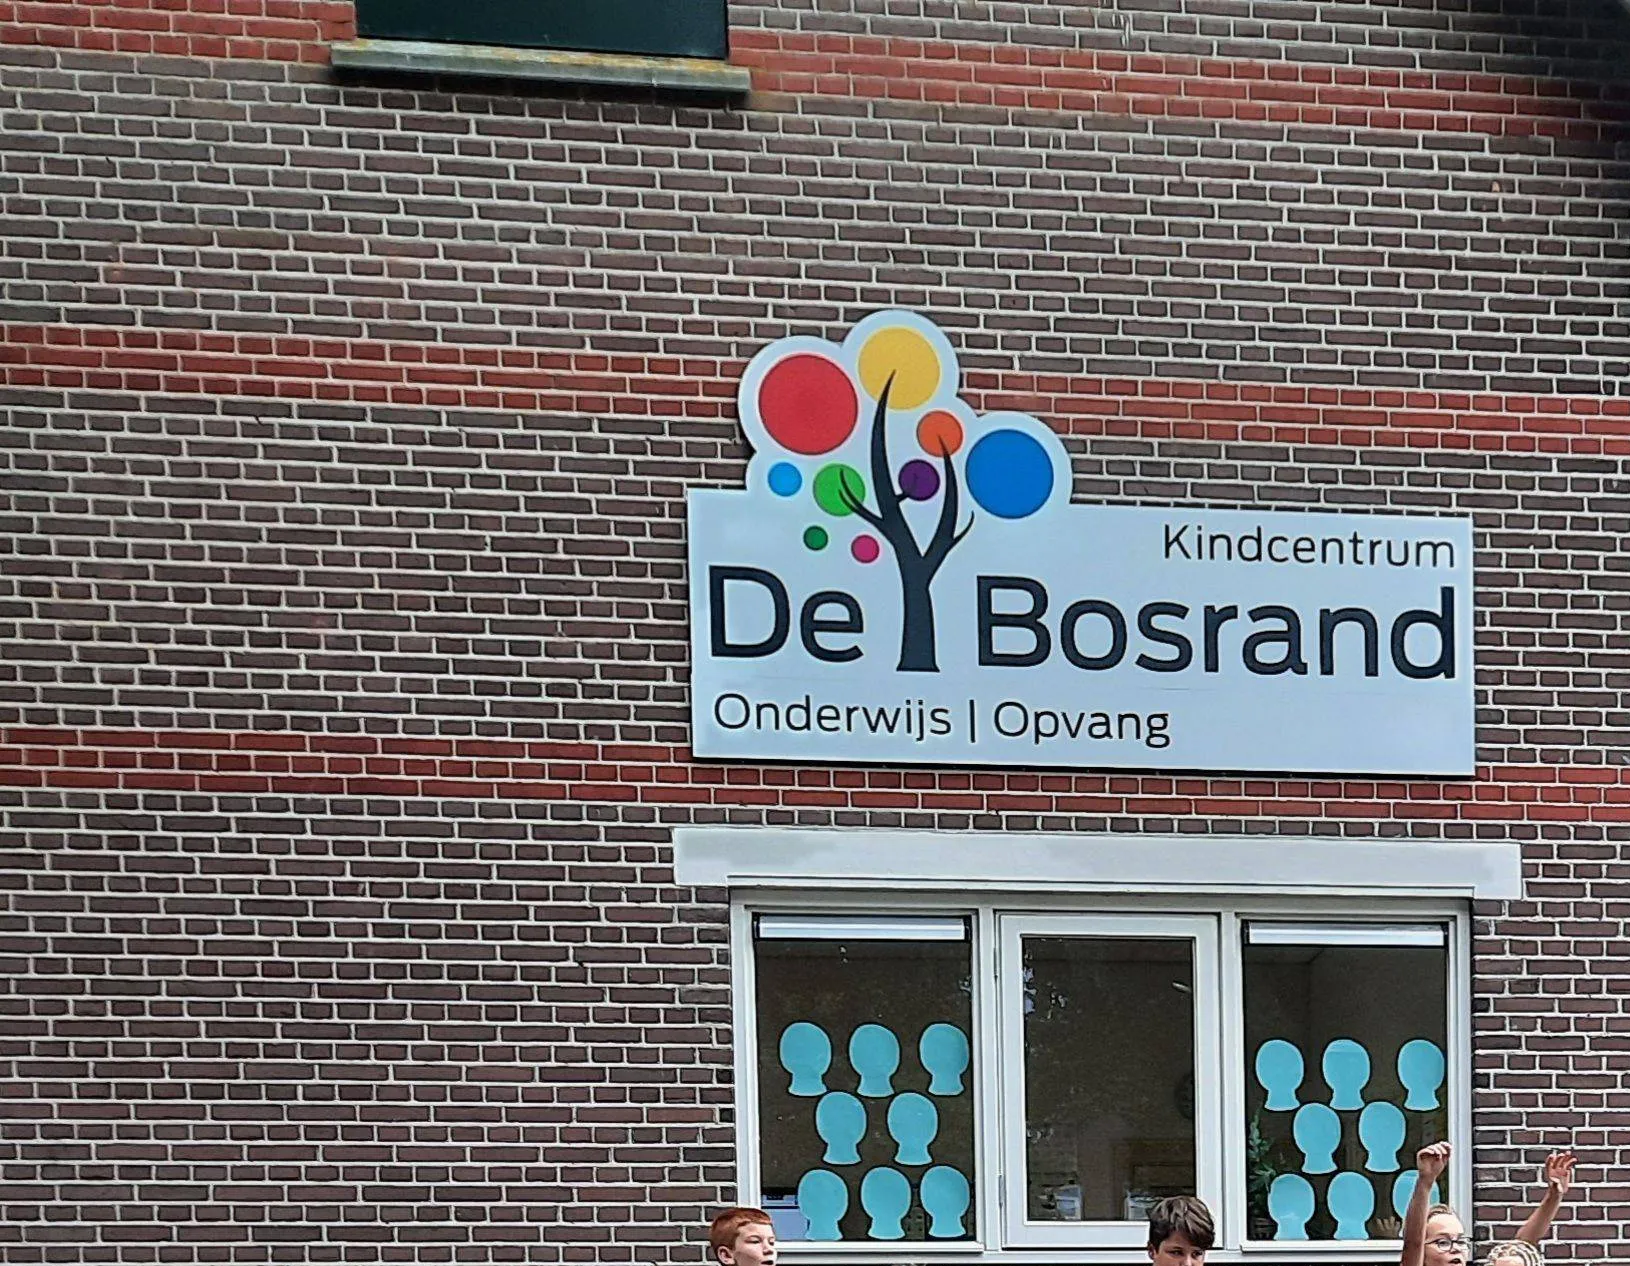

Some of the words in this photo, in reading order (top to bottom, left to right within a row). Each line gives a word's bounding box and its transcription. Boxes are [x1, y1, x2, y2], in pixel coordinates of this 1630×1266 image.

[1164, 523, 1454, 568] Kindcentrum
[708, 564, 864, 663] De
[976, 575, 1456, 680] Bosrand
[714, 692, 952, 744] Onderwijs
[992, 700, 1171, 749] Opvang
